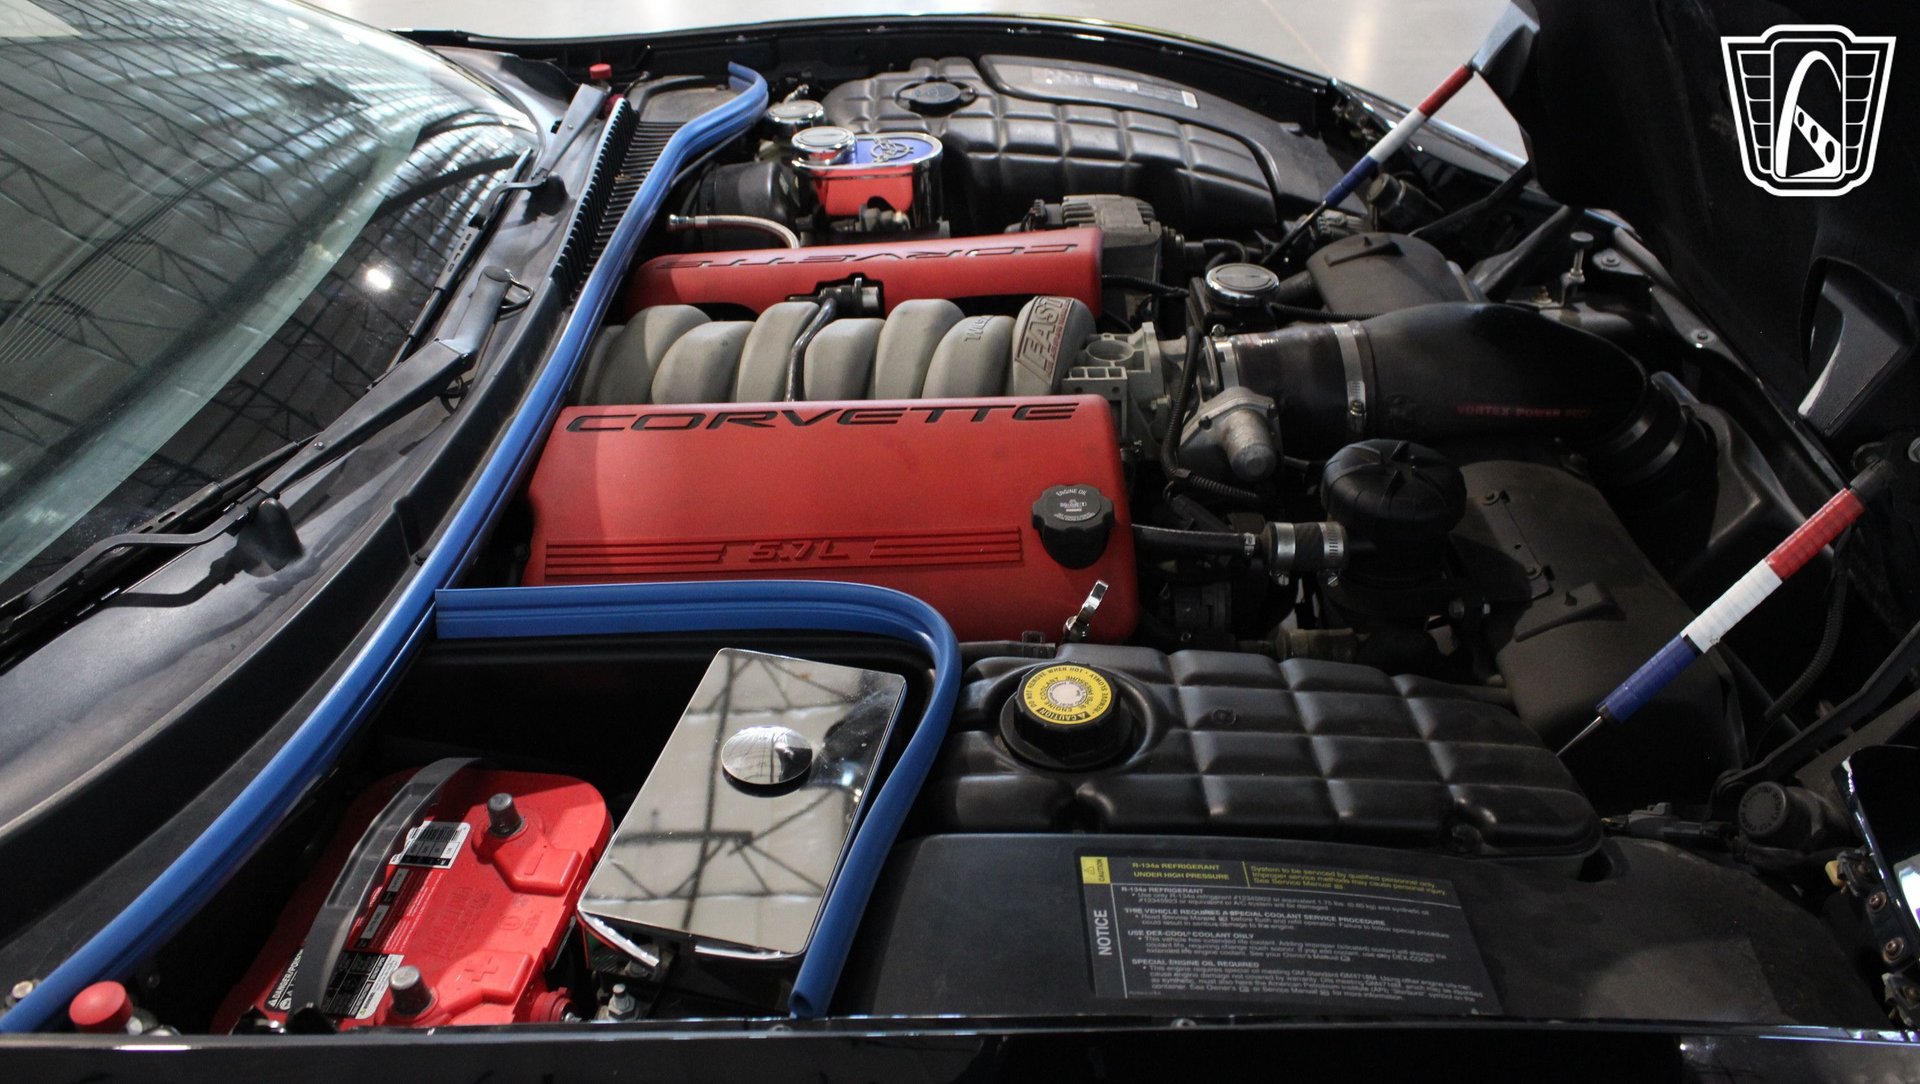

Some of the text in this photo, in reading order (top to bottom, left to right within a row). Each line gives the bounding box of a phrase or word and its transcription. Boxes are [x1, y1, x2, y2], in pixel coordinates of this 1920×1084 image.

[656, 243, 1079, 269] CORVETTE
[1022, 297, 1063, 355] FAST
[566, 402, 1079, 433] CORVETTE
[1455, 405, 1511, 417] VORTEX
[748, 539, 852, 563] 5.7L
[1039, 708, 1077, 721] CAUTION
[1251, 865, 1280, 874] System
[1303, 913, 1336, 921] SERVICE
[1338, 916, 1385, 925] PROCEDURE
[1093, 909, 1112, 955] NOTICE
